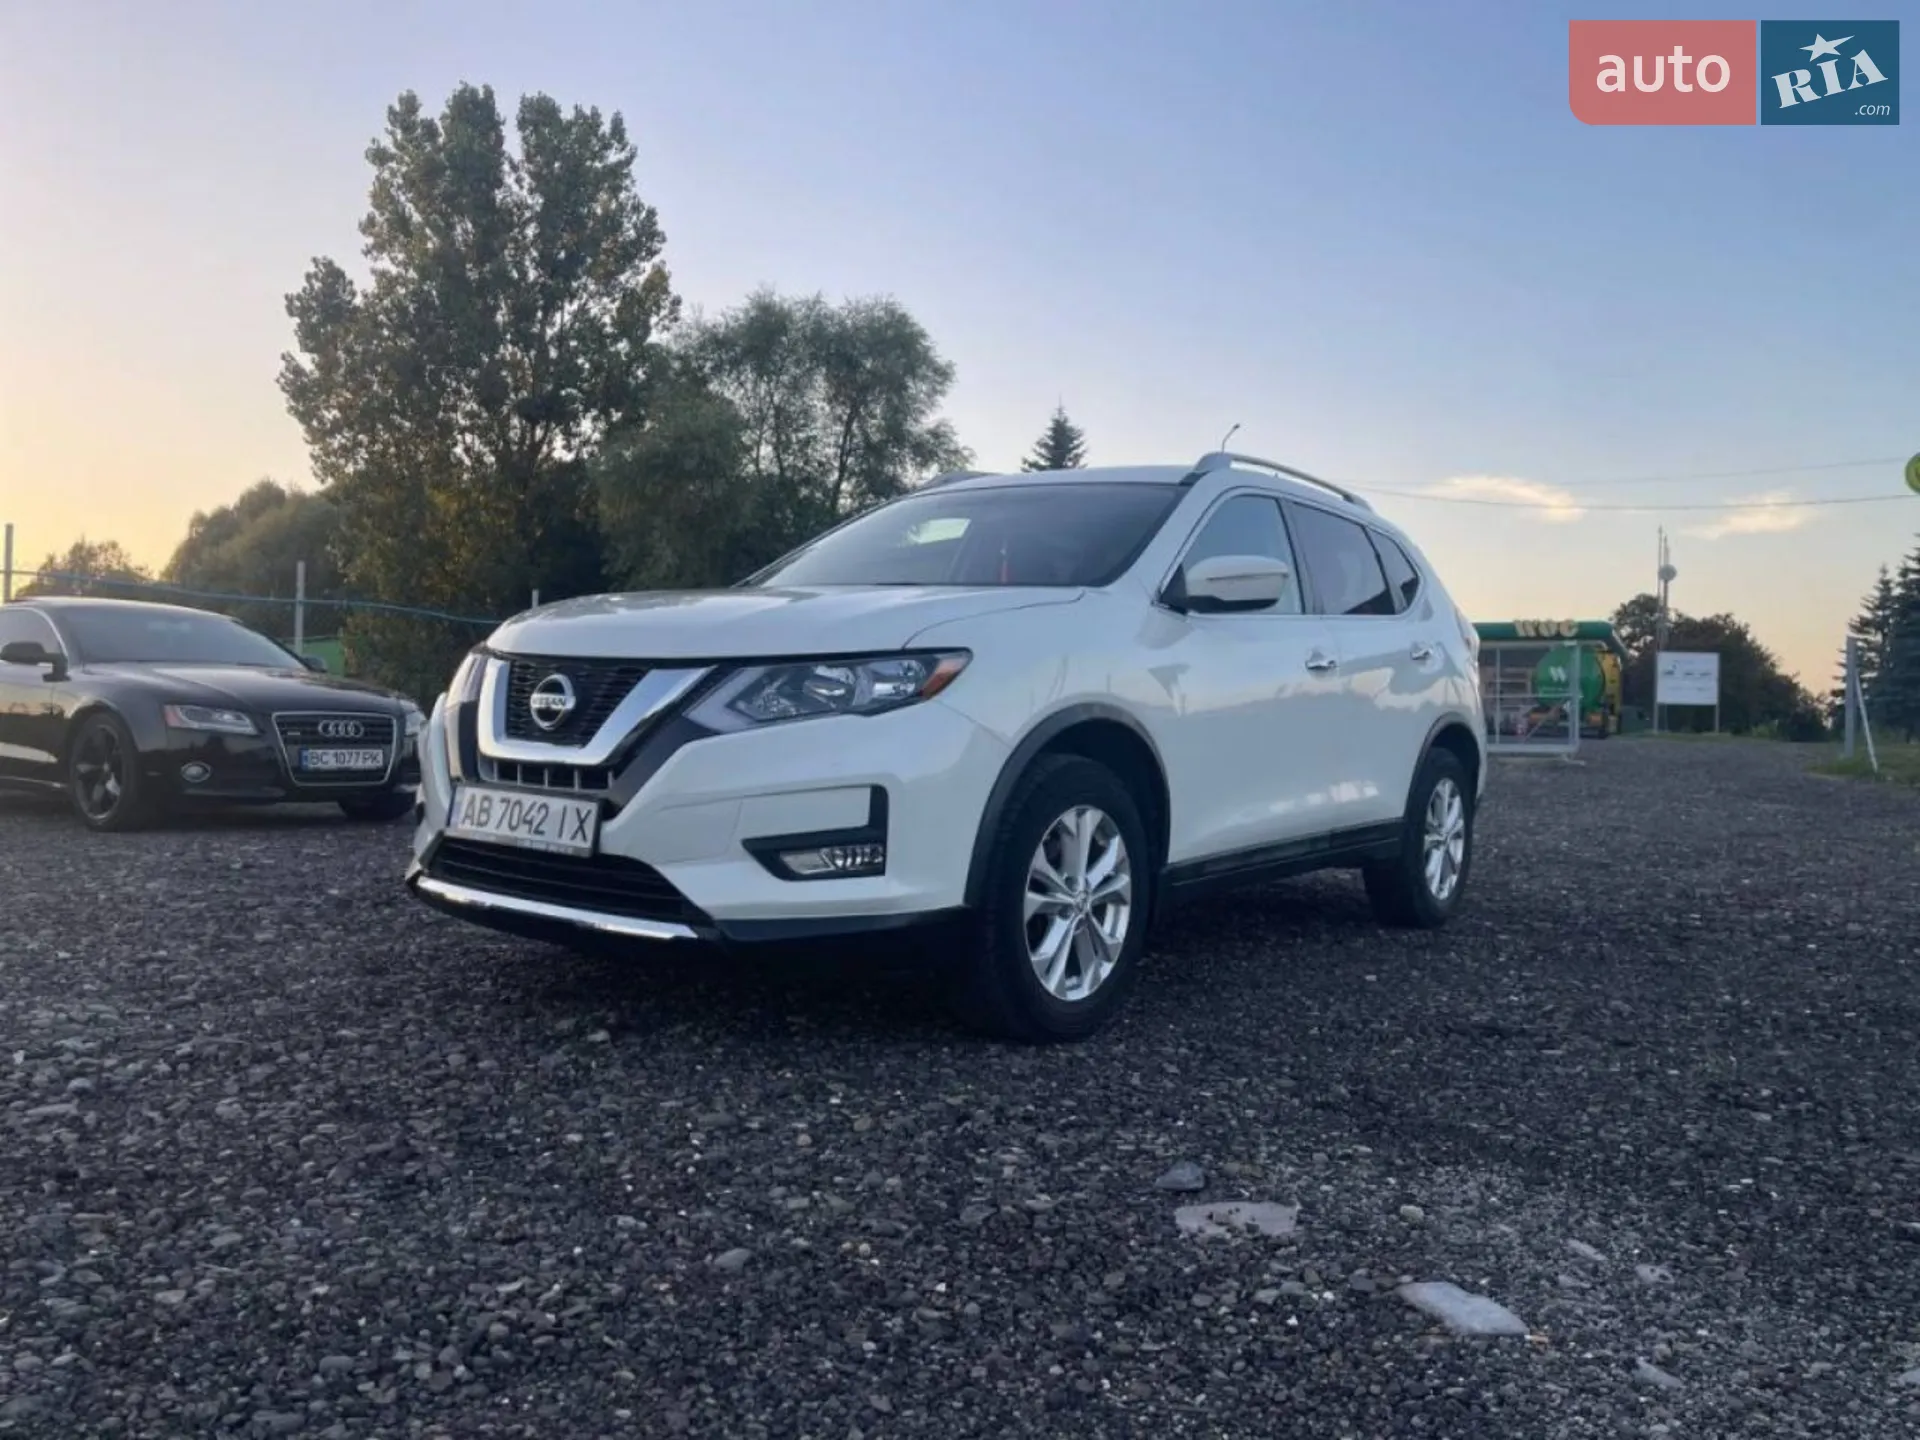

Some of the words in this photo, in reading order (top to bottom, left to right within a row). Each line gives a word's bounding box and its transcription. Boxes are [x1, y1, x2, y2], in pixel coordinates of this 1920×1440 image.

[310, 751, 329, 766] BC
[333, 751, 361, 765] 1077
[362, 752, 381, 766] PK
[462, 793, 492, 827] AB
[496, 798, 549, 836] 7042
[557, 805, 593, 843] IX
